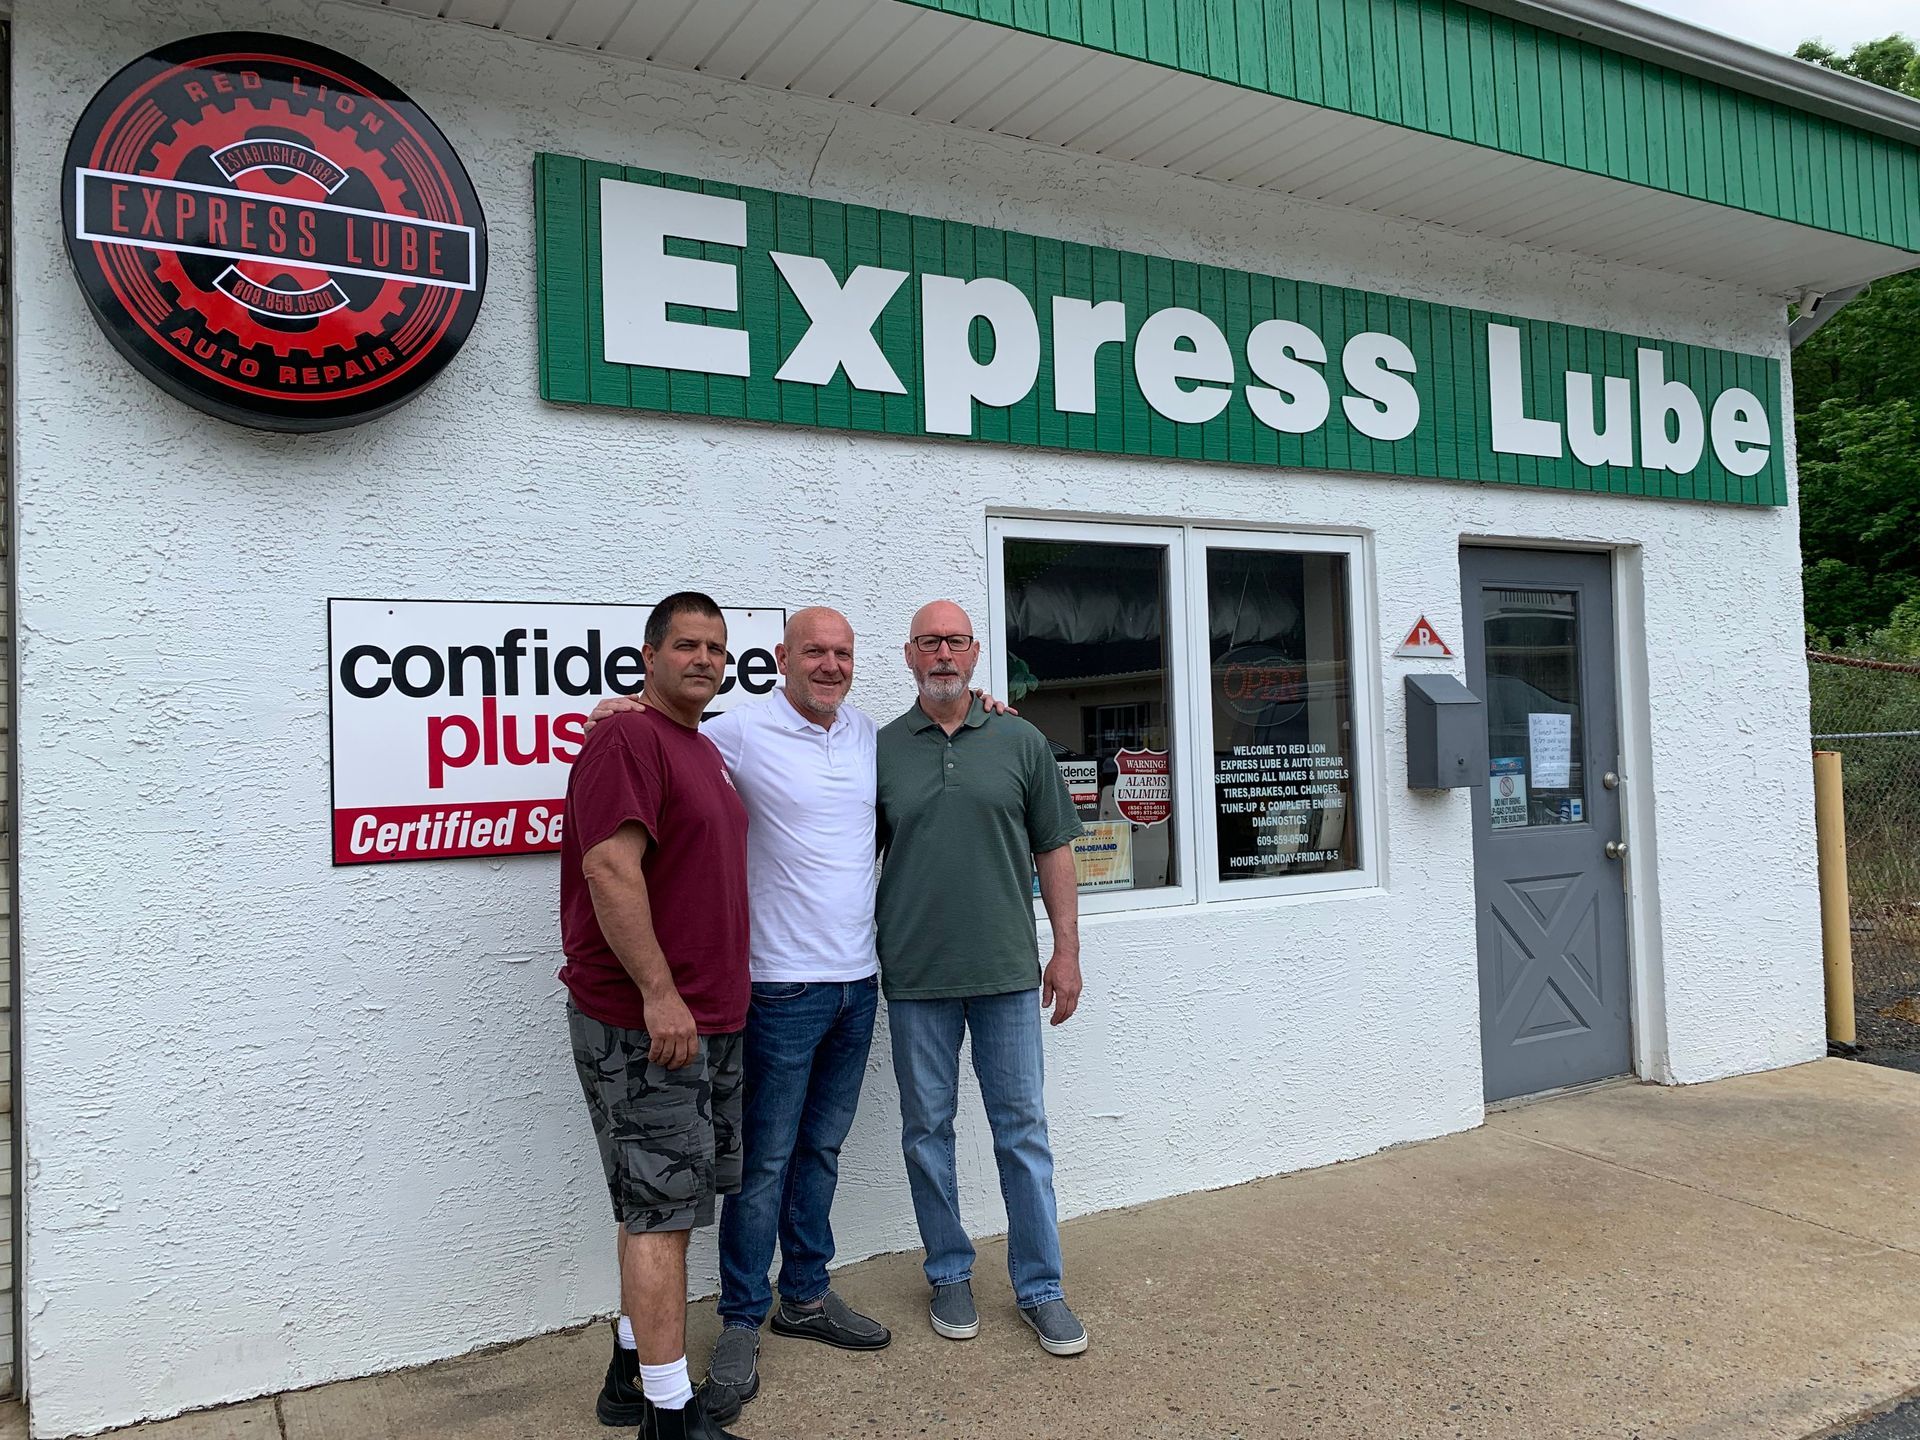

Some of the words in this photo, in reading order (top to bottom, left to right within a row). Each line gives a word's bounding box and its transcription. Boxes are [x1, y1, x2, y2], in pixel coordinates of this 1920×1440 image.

[184, 71, 262, 102] RED
[292, 76, 385, 135] LION
[220, 145, 306, 173] ESTABLISHED
[307, 158, 340, 186] 1987
[111, 184, 316, 257] EXPRESS
[347, 217, 444, 275] LUBE
[600, 177, 1420, 441] Express
[1487, 322, 1771, 477] Lube
[172, 326, 260, 378] AUTO
[279, 346, 395, 386] REPAIR
[340, 629, 778, 698] confidee
[427, 697, 587, 789] plus
[1233, 745, 1274, 756] WELCOME
[1276, 745, 1287, 754] TO
[1289, 745, 1305, 754] RED
[1307, 744, 1326, 754] LION
[1126, 759, 1167, 769] WARNING!
[1220, 760, 1258, 770] EXPRESS
[1260, 759, 1281, 769] LUBE
[1283, 759, 1290, 768] &
[1292, 758, 1313, 767] AUTO
[1315, 757, 1343, 766] REPAIR
[1060, 766, 1096, 778] idence
[1215, 773, 1260, 784] SERVICING
[1262, 772, 1277, 782] ALL
[1279, 771, 1307, 781] MAKES
[1309, 771, 1315, 779] &
[1317, 770, 1349, 779] MODELS
[1126, 776, 1167, 787] ALARMS
[1221, 802, 1257, 813] TUNE-UP
[1259, 802, 1266, 811] &
[1268, 800, 1311, 811] COMPLETE
[1312, 799, 1343, 809] ENGINE
[1252, 815, 1307, 828] DIAGNOSTICS
[350, 808, 517, 855] Certified
[1256, 833, 1309, 846] 609-859-0500
[1074, 843, 1117, 853] ON-DEMAND
[1326, 850, 1339, 860] 8-5
